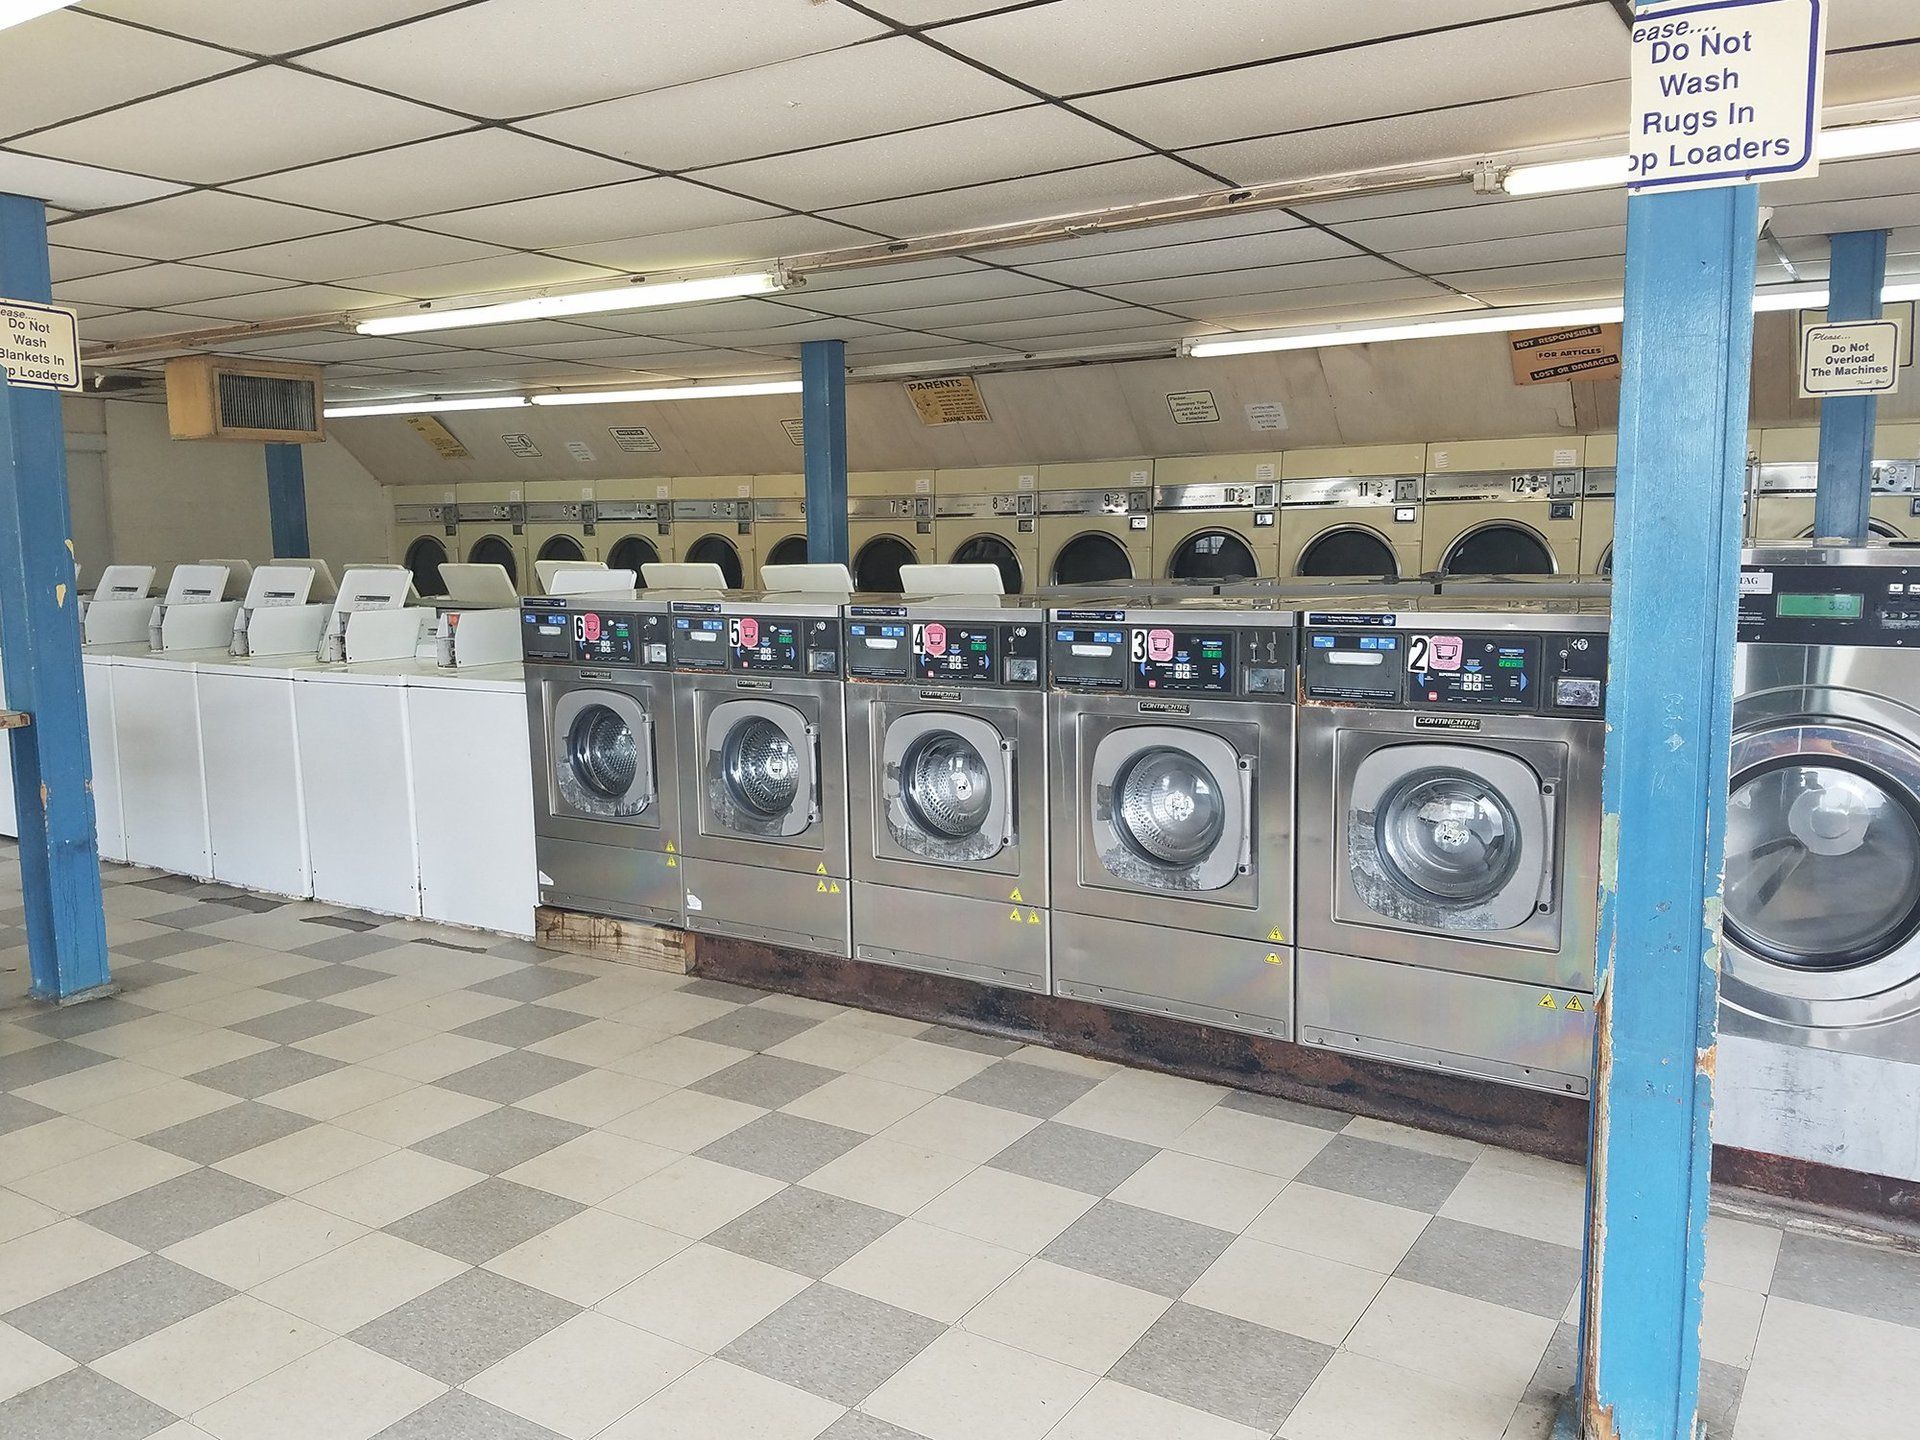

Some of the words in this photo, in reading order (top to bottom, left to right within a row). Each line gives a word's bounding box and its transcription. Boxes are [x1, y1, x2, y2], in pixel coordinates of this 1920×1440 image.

[1651, 40, 1689, 64] Do
[1701, 30, 1752, 57] Not
[1659, 67, 1739, 97] Wash
[1643, 109, 1718, 137] Rugs
[1729, 103, 1754, 125] In
[1669, 137, 1790, 167] Loaders
[8, 318, 26, 330] Do
[29, 321, 51, 333] Not
[13, 334, 47, 348] Wash
[1516, 339, 1535, 349] NOT
[1538, 327, 1600, 344] RESPONSIBLE
[1560, 347, 1602, 357] ARTICLES
[1831, 344, 1846, 353] Do
[1850, 343, 1869, 352] Not
[53, 355, 65, 366] In
[1825, 353, 1875, 365] Overload
[20, 366, 70, 382] Loaders
[1533, 369, 1556, 379] LOST
[1557, 365, 1570, 374] OR
[1571, 356, 1615, 371] DAMAGED
[1811, 367, 1832, 377] The
[1835, 364, 1888, 376] Machines
[1359, 482, 1368, 497] 11
[1511, 477, 1525, 492] 12
[1104, 493, 1110, 507] 9
[1224, 488, 1235, 502] 10
[890, 501, 897, 513] 7
[992, 497, 998, 510] 8
[576, 616, 584, 640] 6
[730, 620, 740, 646] 5
[914, 625, 925, 653] 4
[1133, 630, 1146, 662] 3
[1409, 637, 1428, 671] 2
